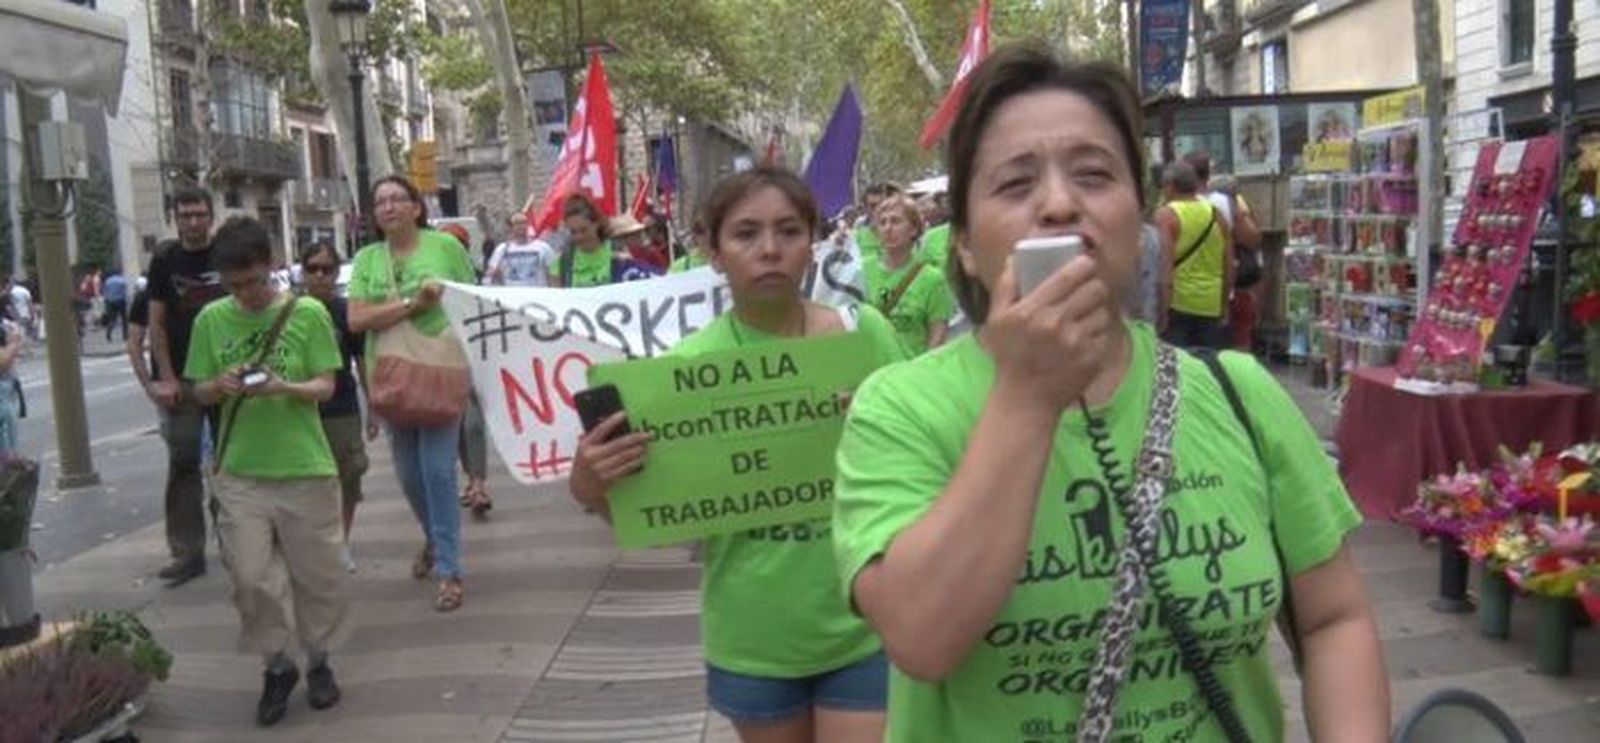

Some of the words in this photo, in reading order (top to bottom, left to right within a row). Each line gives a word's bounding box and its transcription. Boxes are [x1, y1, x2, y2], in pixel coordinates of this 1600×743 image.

[674, 364, 720, 392] NO
[731, 360, 752, 384] A
[761, 352, 798, 379] LA
[731, 449, 770, 474] DE
[641, 478, 834, 528] TRABAJADOR
